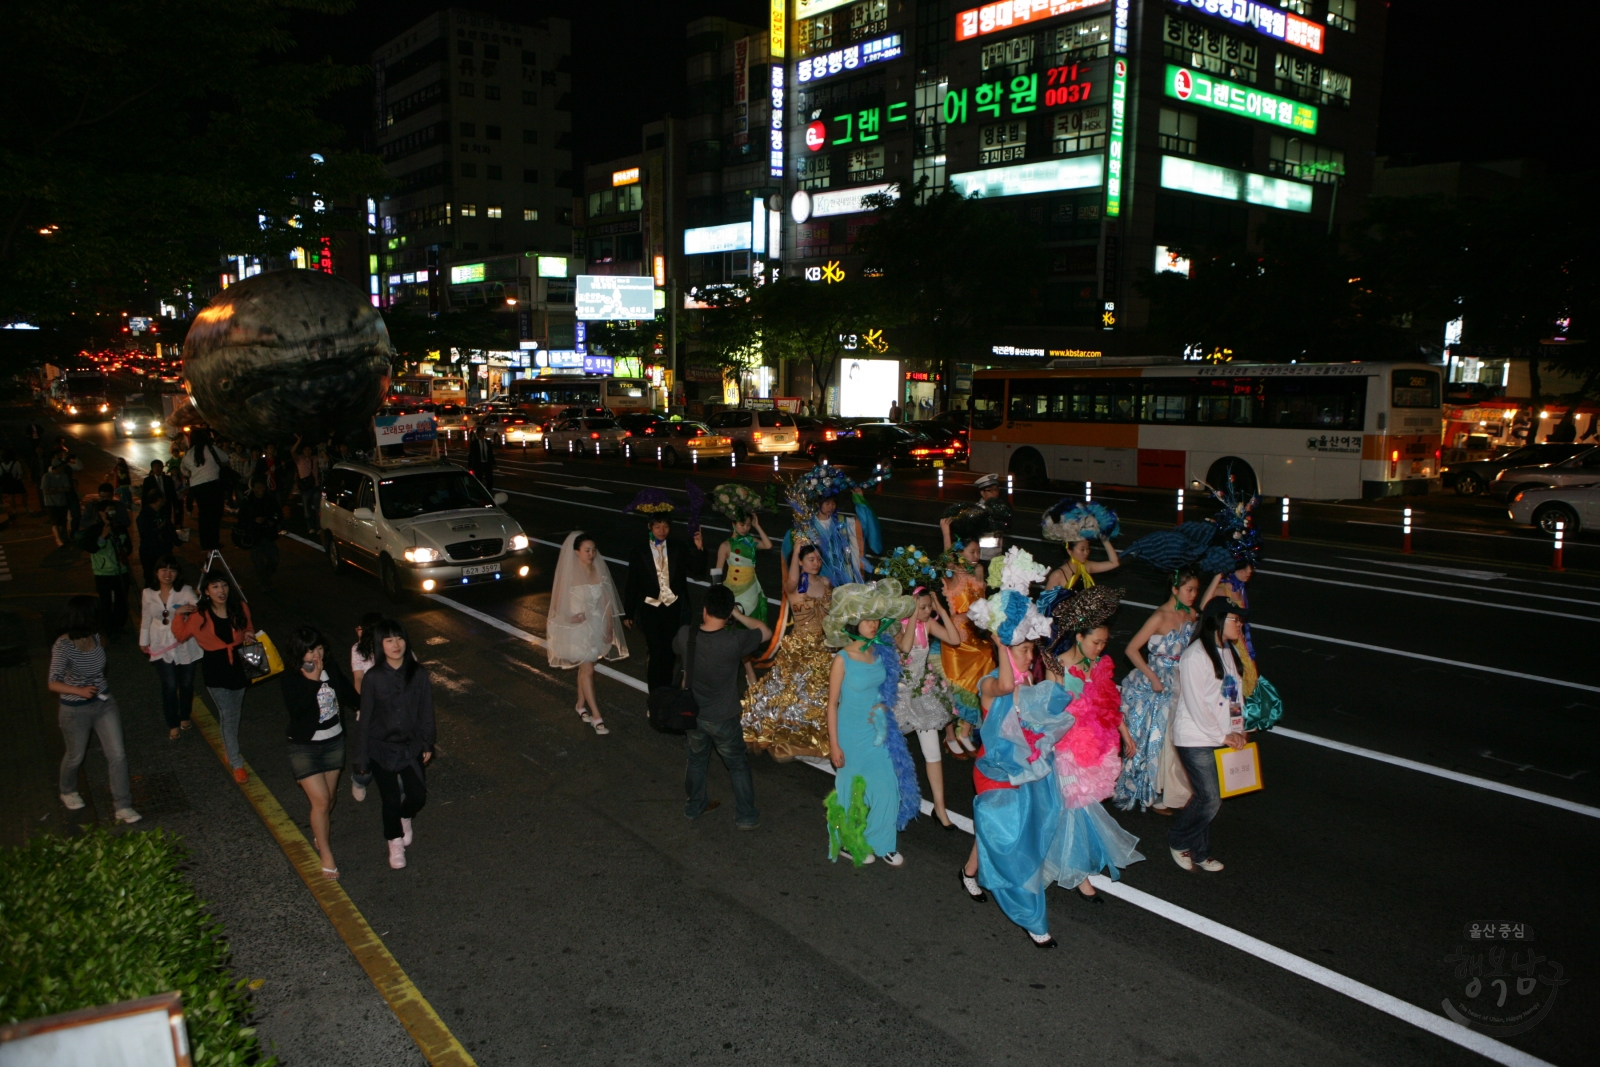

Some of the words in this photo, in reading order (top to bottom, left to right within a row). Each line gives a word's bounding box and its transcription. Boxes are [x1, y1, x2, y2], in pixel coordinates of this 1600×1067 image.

[799, 45, 859, 82] 중앙행정
[943, 73, 1038, 124] 어학원
[1045, 83, 1092, 106] 0037
[1195, 79, 1293, 125] 그랜드어학원
[1111, 80, 1126, 137] 그랜드
[984, 123, 1020, 147] 영문법
[979, 147, 1026, 163] 수시접수
[805, 267, 821, 281] KB
[1105, 302, 1115, 311] KB
[1049, 349, 1102, 358] www.kbstar.com
[381, 423, 414, 436] 고래모형
[1318, 435, 1362, 449] 울산여객
